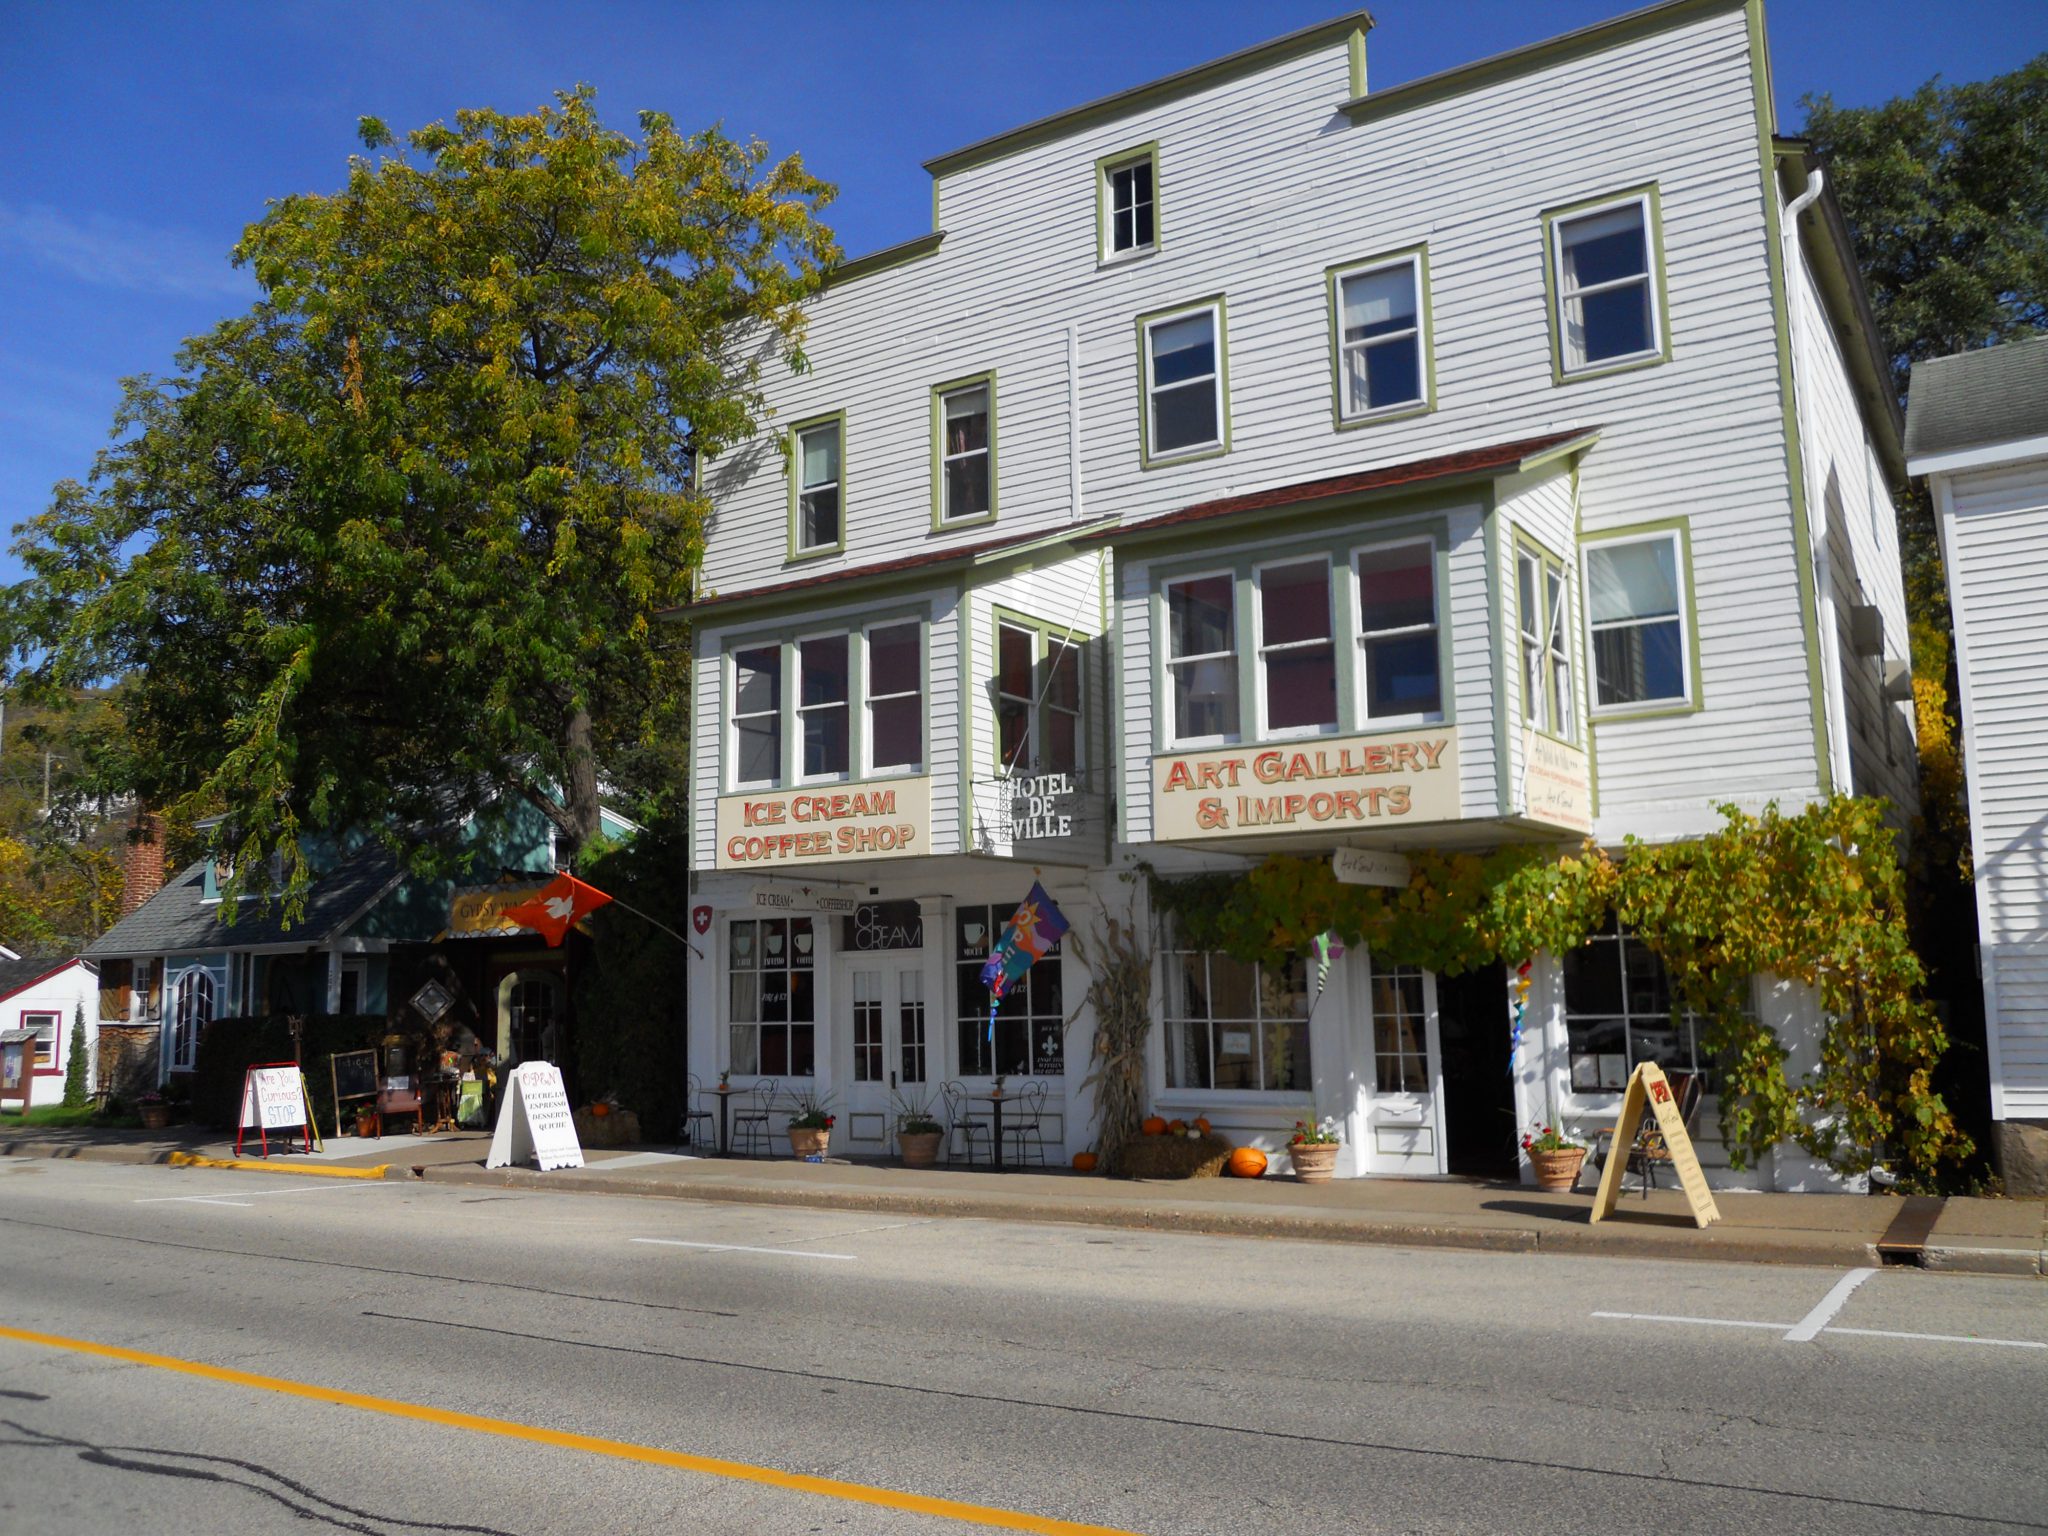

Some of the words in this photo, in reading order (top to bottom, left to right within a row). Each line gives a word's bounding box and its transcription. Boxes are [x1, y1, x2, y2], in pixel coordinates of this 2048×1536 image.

[1163, 758, 1247, 793] ART
[1253, 738, 1448, 785] GALLERY
[1011, 773, 1073, 798] HOTEL
[744, 801, 786, 827] ICE
[791, 789, 896, 822] CREAM
[1029, 796, 1055, 818] DE
[1196, 796, 1230, 829] &
[1237, 785, 1412, 827] IMPORTS
[1012, 815, 1072, 840] VILLE
[727, 831, 832, 861] COFFEE
[837, 824, 915, 853] SHOP
[461, 902, 495, 919] GYPSY
[756, 893, 768, 906] ICE
[768, 894, 790, 908] CREAM
[855, 905, 880, 929] ICE
[856, 925, 922, 950] CREAM
[260, 1072, 275, 1085] Are
[522, 1072, 557, 1087] OPEN
[261, 1087, 302, 1102] Curious?
[538, 1091, 565, 1099] CREAM
[268, 1105, 296, 1125] STOP
[530, 1101, 567, 1109] ESPRESSO
[533, 1112, 569, 1120] DESSERTS
[539, 1122, 567, 1131] QUICHE
